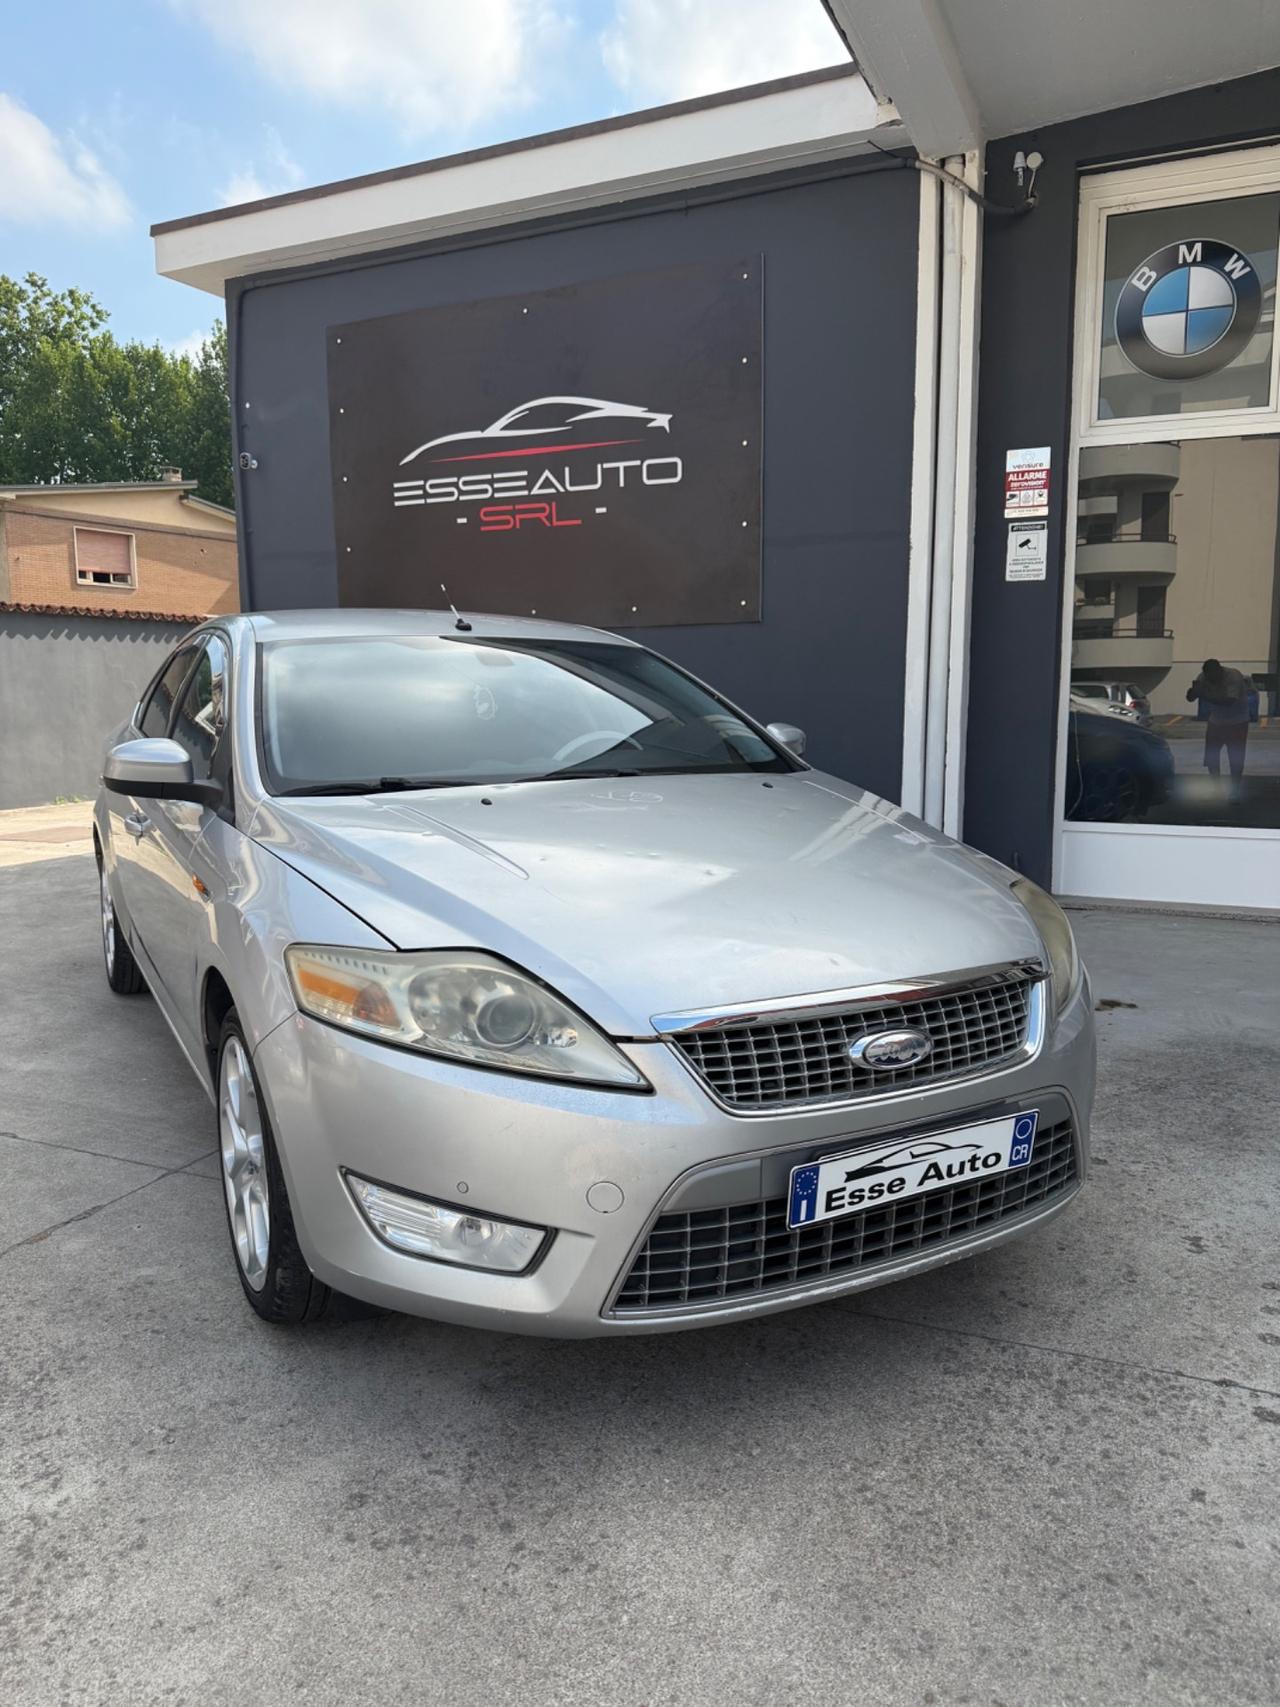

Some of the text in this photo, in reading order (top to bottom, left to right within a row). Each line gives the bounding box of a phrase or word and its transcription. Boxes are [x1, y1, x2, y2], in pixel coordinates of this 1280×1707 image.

[1131, 242, 1251, 292] BMW
[393, 457, 682, 506] ESSEAUTO
[1008, 471, 1047, 482] ALLARME
[1012, 1144, 1029, 1161] CR
[825, 1152, 1002, 1213] Esse Auto
